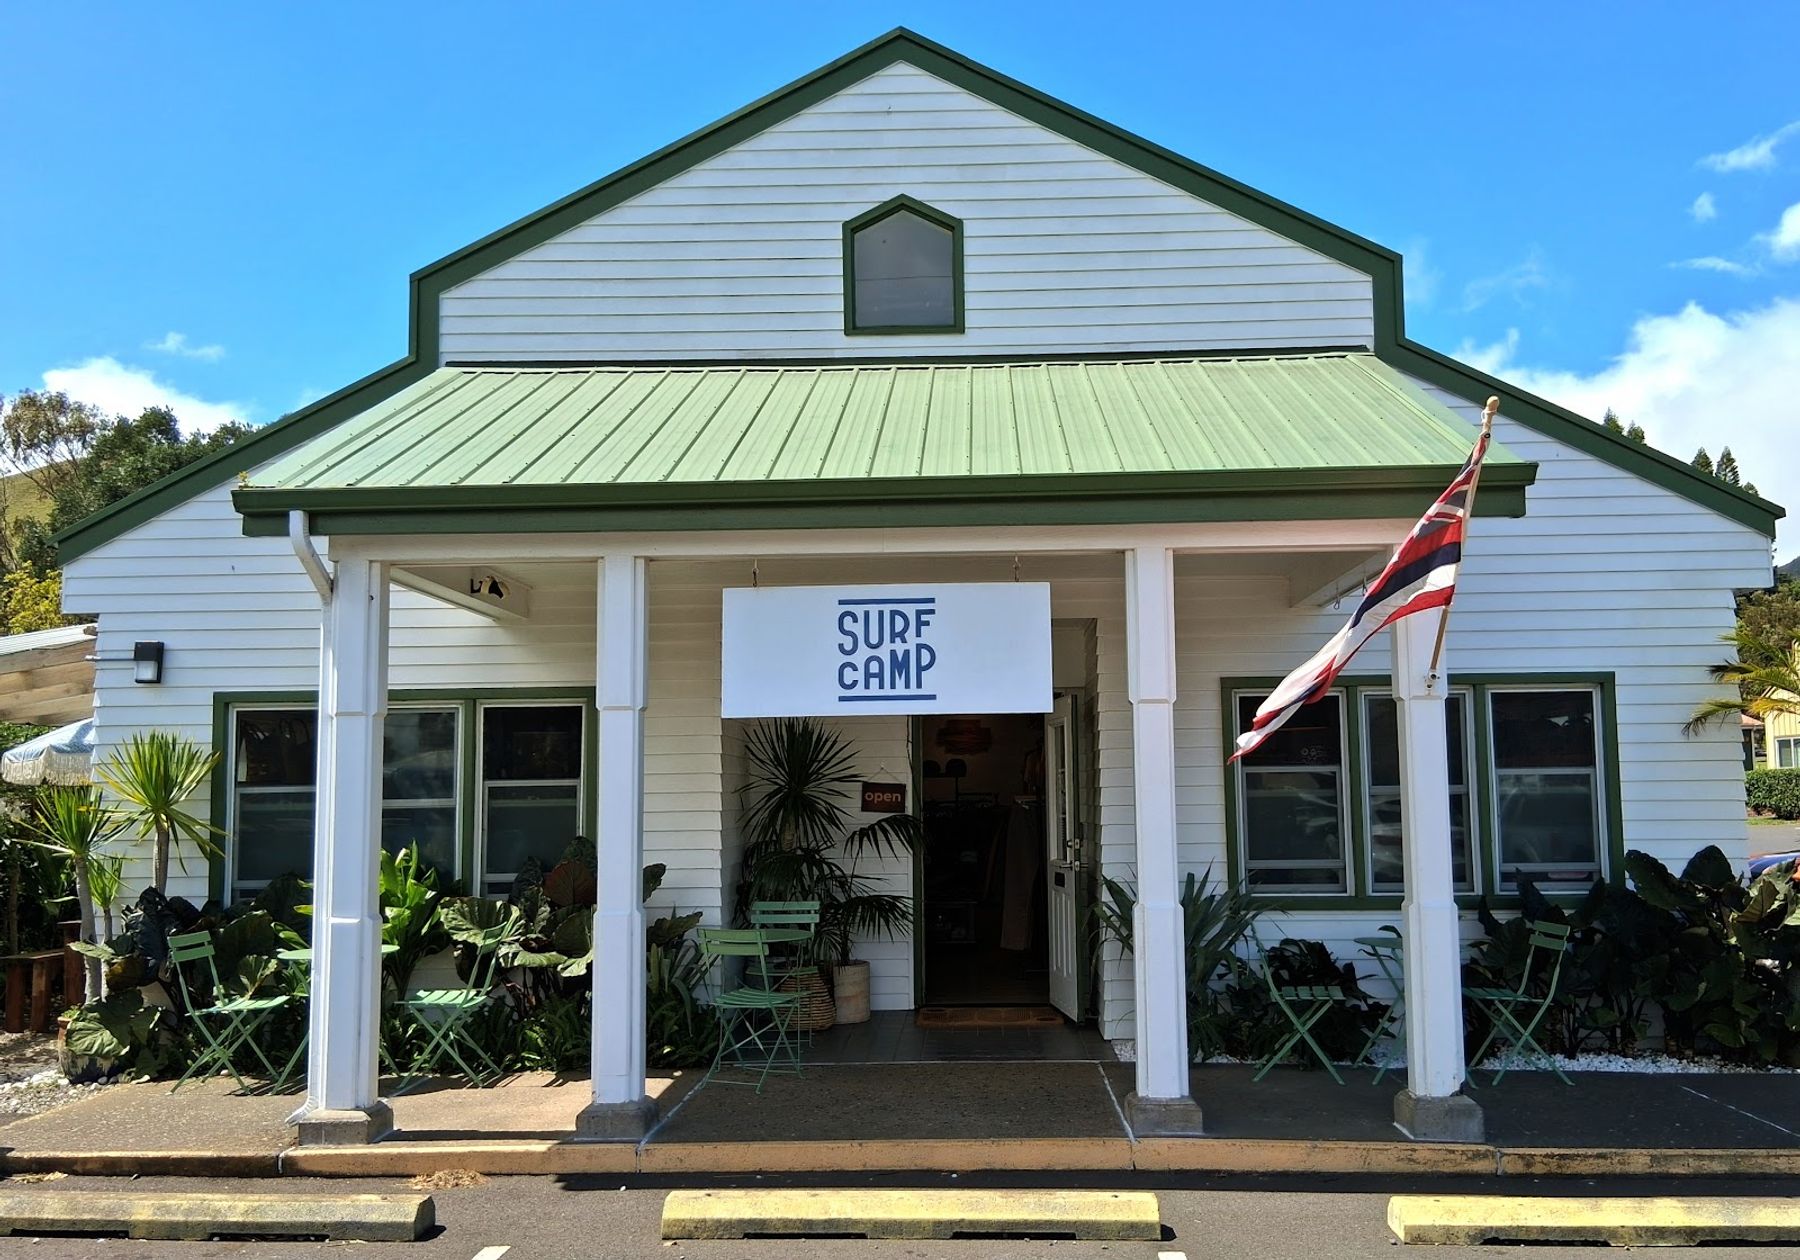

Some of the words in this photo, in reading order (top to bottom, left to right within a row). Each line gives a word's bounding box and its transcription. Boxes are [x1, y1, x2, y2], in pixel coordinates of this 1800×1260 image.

[838, 608, 936, 656] SURF
[838, 643, 936, 690] CAMP
[864, 791, 901, 804] open
